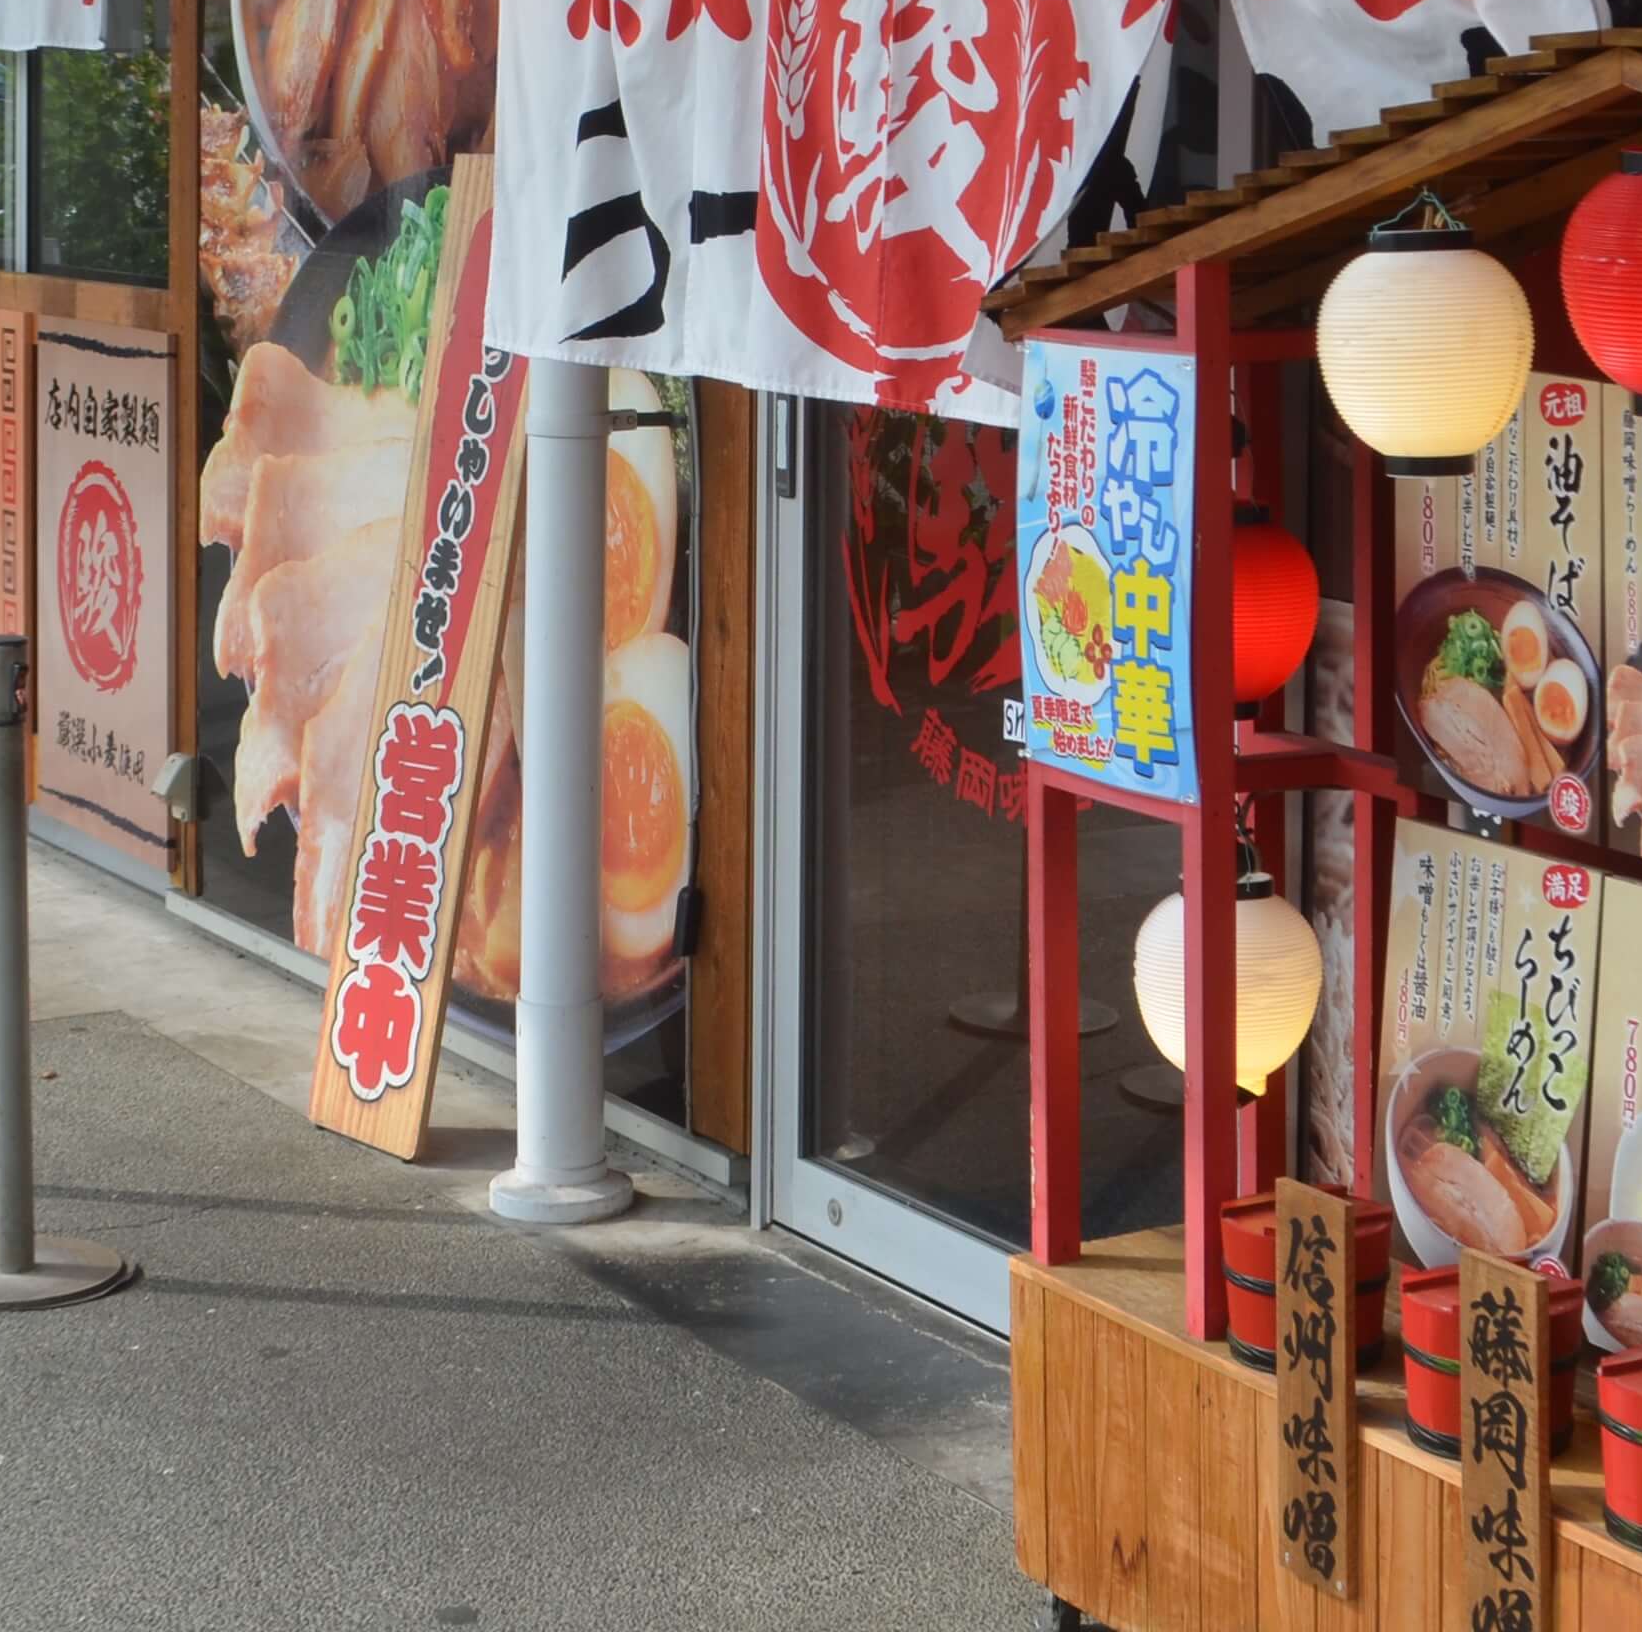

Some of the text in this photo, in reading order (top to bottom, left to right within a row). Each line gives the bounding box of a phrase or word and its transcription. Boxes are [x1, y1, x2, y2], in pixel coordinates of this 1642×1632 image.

[44, 378, 161, 454] 店内自家製麺
[1062, 395, 1079, 509] 新鮮食材
[1079, 358, 1097, 528] 駿こだわりの
[1543, 390, 1585, 421] 元祖
[1101, 368, 1180, 776] 冷やし中華
[1545, 433, 1587, 618] 油そば
[56, 710, 146, 787] 厳選小麦使用
[1030, 694, 1093, 729] 夏季限定で
[1051, 726, 1116, 761] 始めました!
[334, 703, 463, 1102] 営業中
[1411, 854, 1435, 1021] 味噌もしくは醤油
[1545, 869, 1588, 902] 満足
[1502, 930, 1543, 1116] らーめん
[1547, 914, 1580, 1112] ちびっこ
[1623, 1018, 1640, 1121] 780円
[1281, 1211, 1338, 1583] 信州味噌
